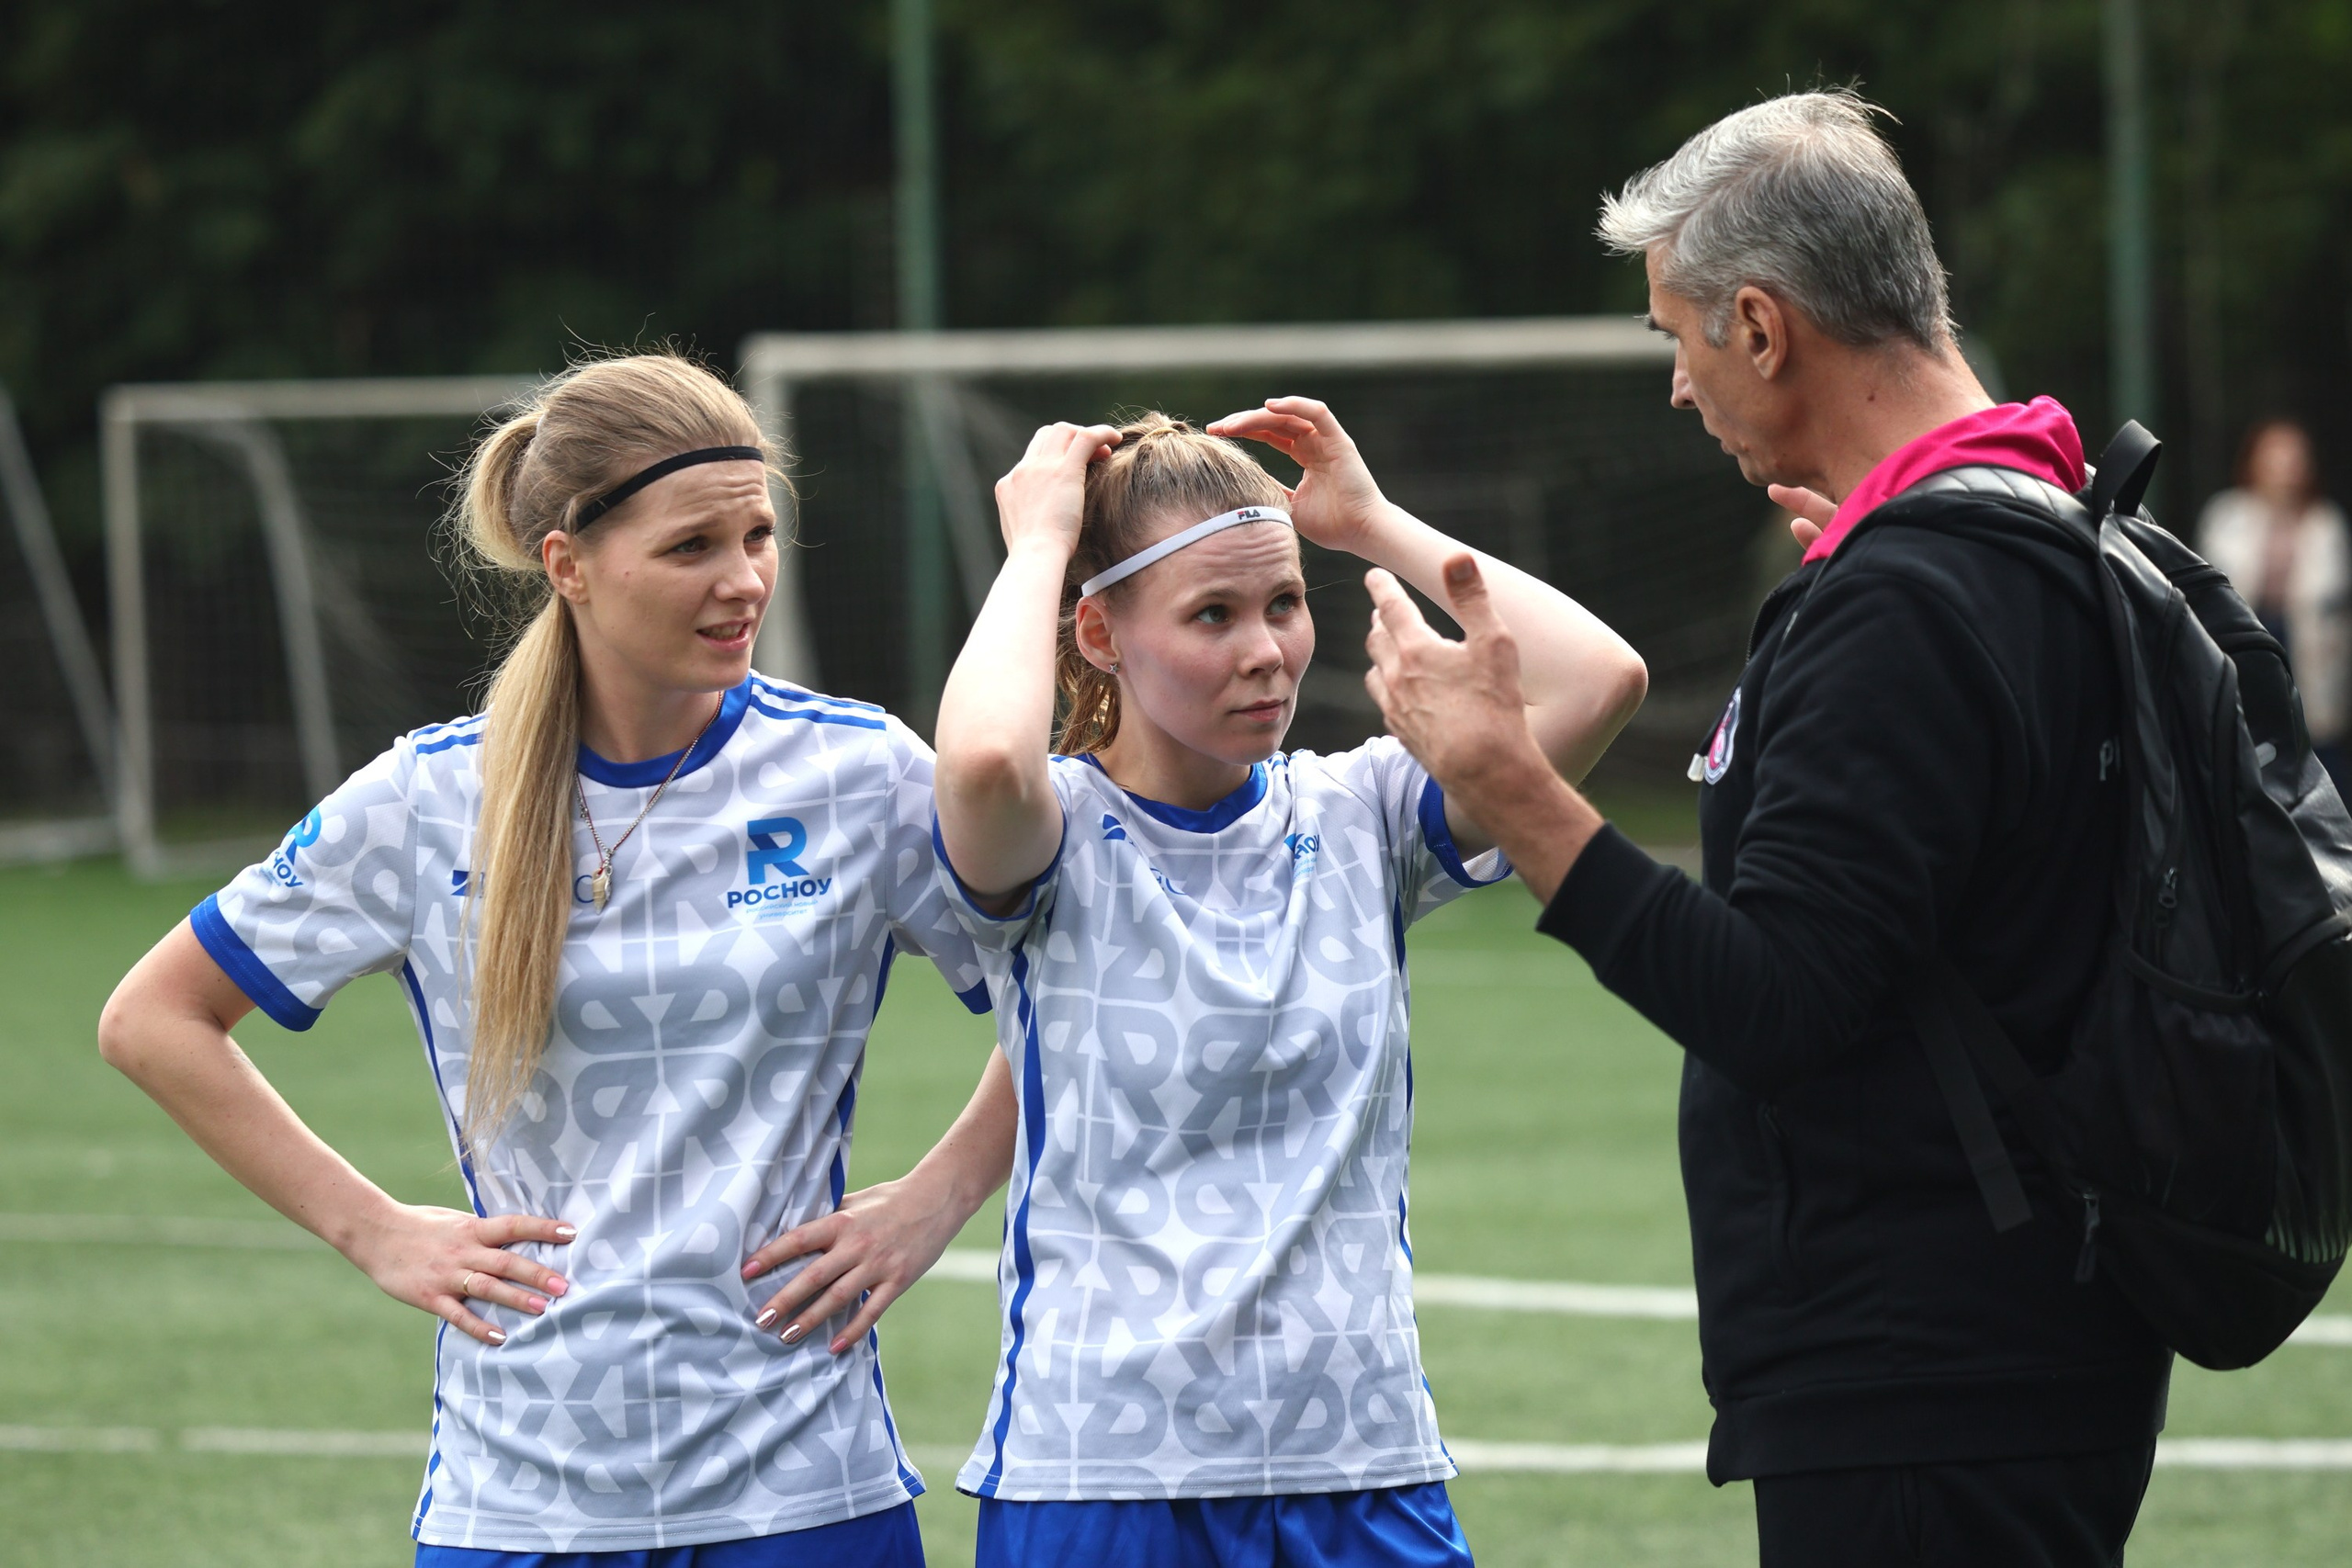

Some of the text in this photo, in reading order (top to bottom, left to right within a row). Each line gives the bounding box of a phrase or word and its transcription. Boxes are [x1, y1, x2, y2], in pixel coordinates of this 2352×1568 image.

[1237, 509, 1261, 520] FILA
[747, 817, 810, 886] R
[727, 877, 832, 909] РОСНОУ
